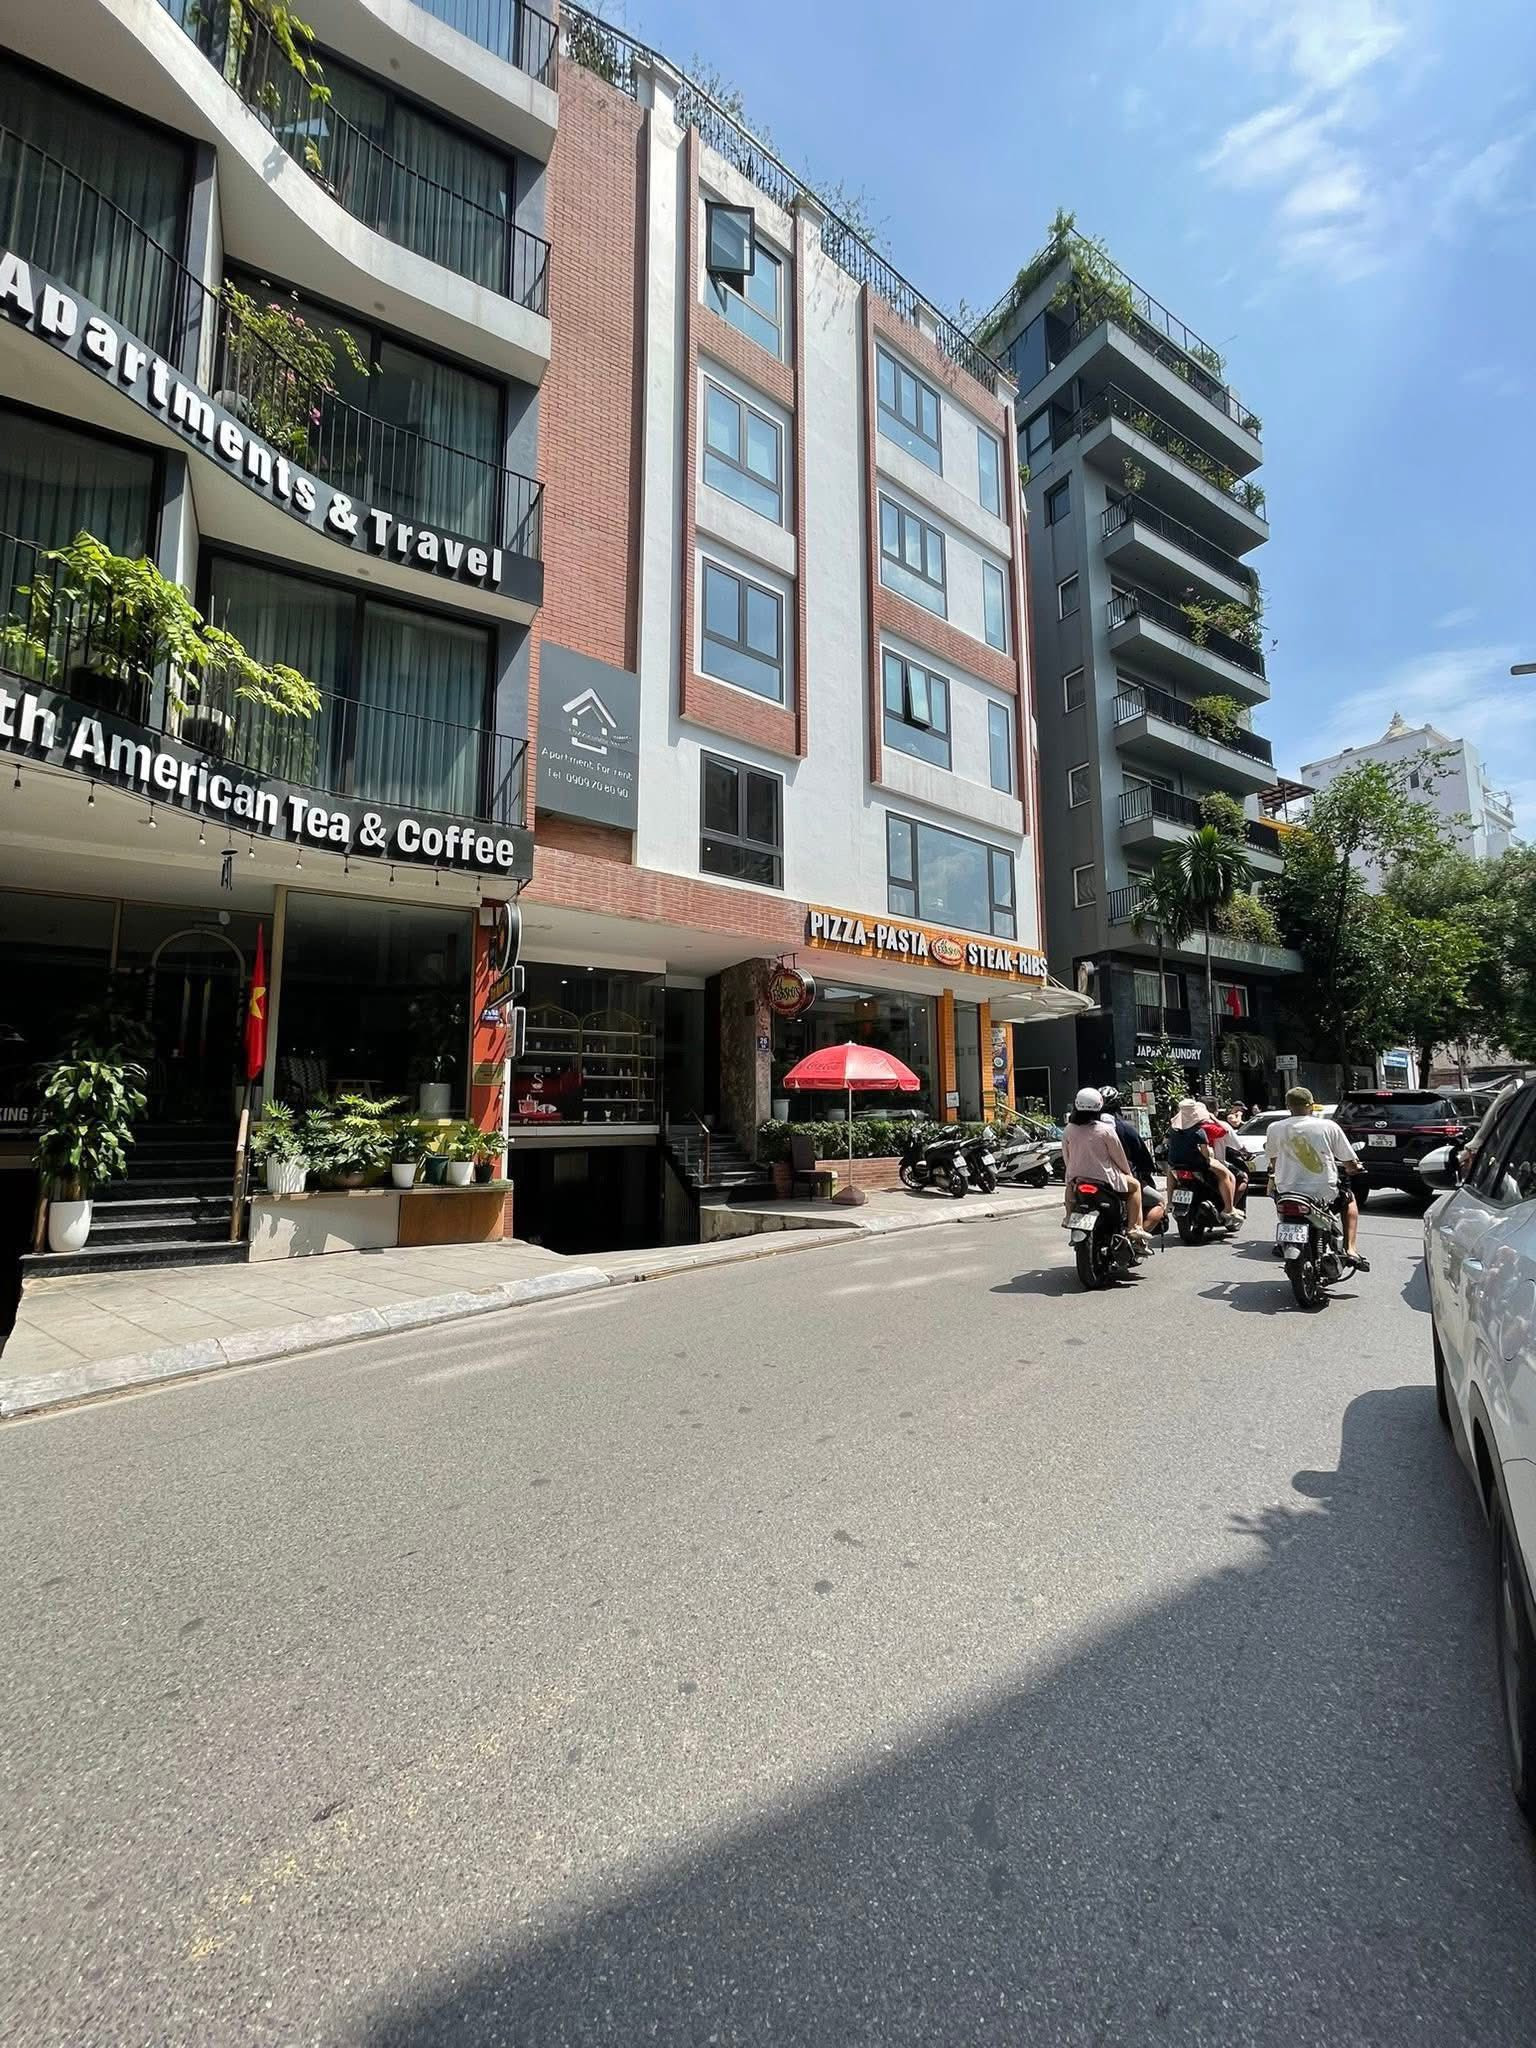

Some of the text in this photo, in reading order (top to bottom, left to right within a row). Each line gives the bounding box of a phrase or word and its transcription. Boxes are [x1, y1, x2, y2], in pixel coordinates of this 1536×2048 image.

[0, 252, 503, 582] Apartments & Travel
[0, 689, 514, 867] th American Tea & Coffee
[541, 747, 594, 770] Apartment
[811, 911, 1048, 977] PIZZA-PASTA STEAK-RIBS
